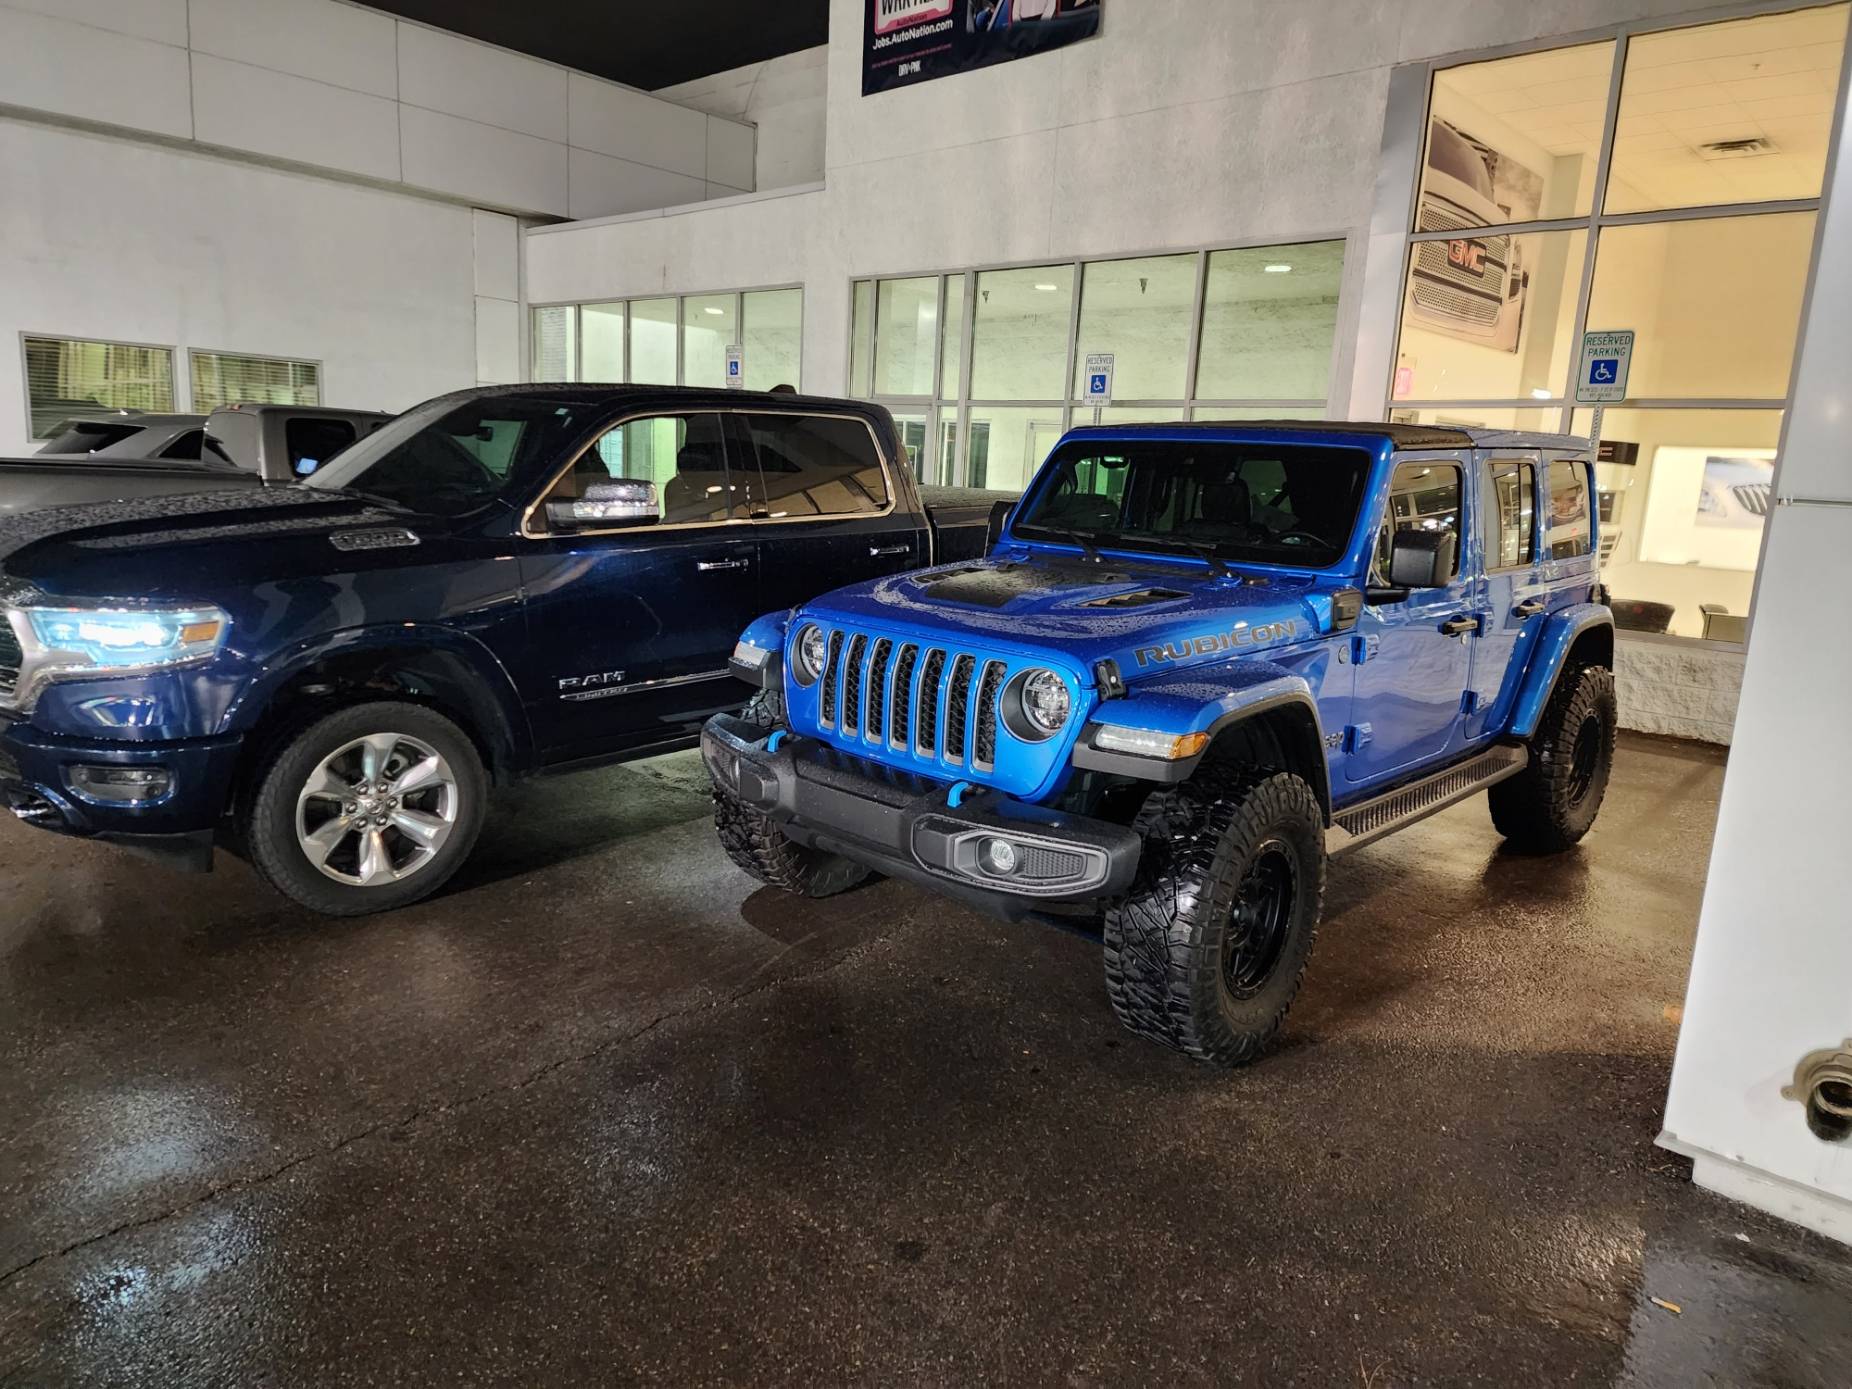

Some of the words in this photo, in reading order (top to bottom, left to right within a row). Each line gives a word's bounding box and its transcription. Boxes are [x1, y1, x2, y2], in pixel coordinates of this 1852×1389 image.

[872, 19, 953, 50] Jobs.AutoNation.com
[1449, 239, 1486, 273] GMC
[1586, 336, 1630, 345] RESERVED
[1588, 347, 1626, 356] PARKING
[1134, 620, 1297, 667] RUBICON
[559, 670, 626, 690] RAM
